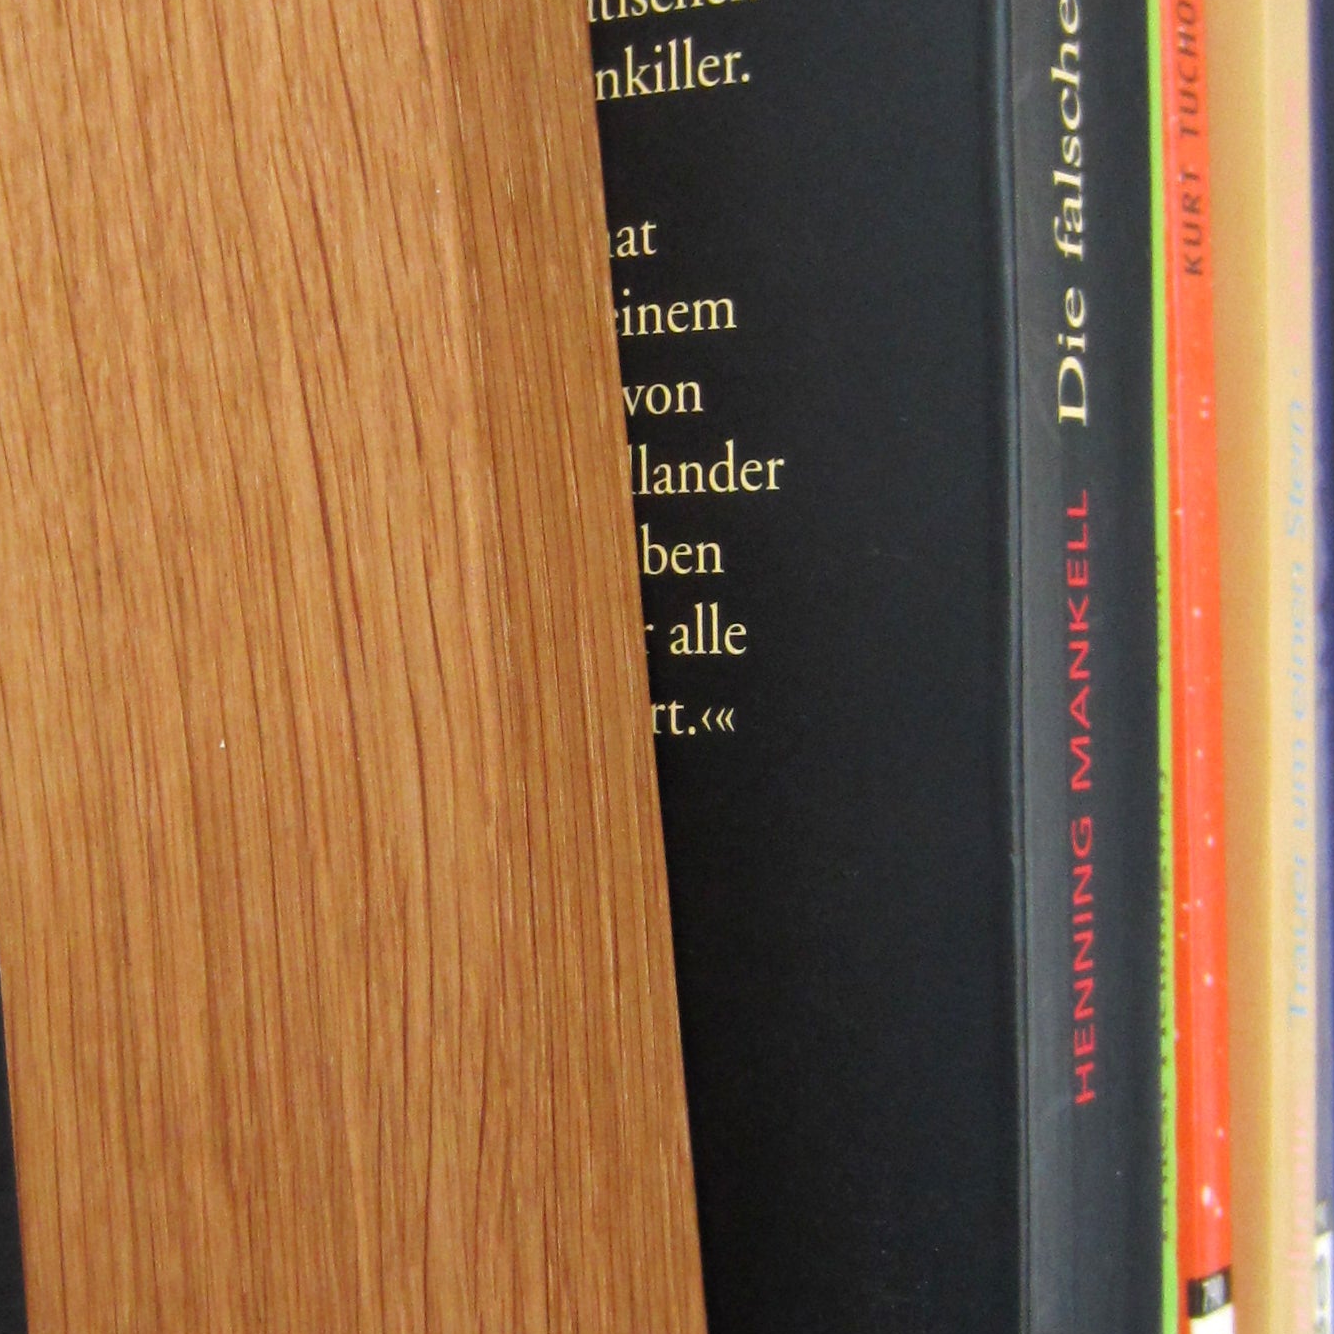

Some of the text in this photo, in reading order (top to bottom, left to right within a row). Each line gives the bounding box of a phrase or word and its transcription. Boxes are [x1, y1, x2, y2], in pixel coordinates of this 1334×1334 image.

[1178, 165, 1204, 278] KURT
[615, 288, 738, 336] inem
[1055, 285, 1090, 428] Die
[623, 380, 705, 418] von
[640, 522, 726, 575] ben
[669, 601, 748, 655] alle
[1065, 488, 1097, 1106] HENNING MANKELL
